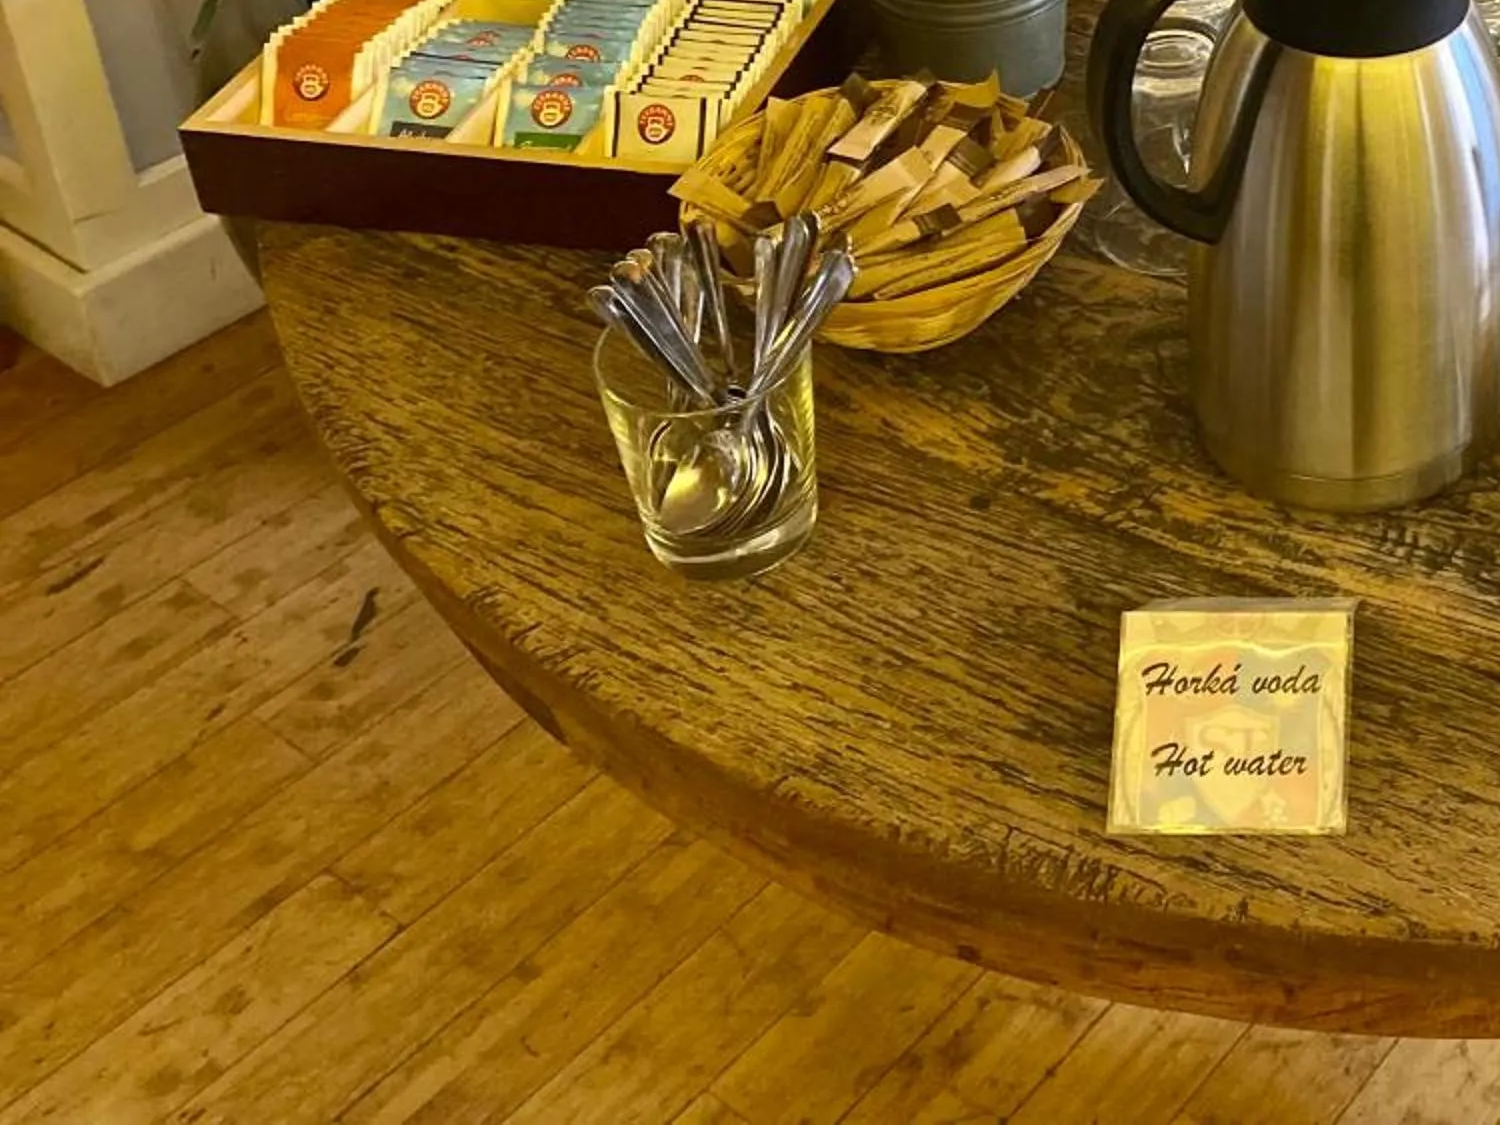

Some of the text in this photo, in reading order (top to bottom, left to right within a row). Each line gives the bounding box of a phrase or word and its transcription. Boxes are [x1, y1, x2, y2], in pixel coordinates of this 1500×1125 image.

[1141, 661, 1322, 697] Horká voda
[1151, 742, 1309, 777] Hot water
